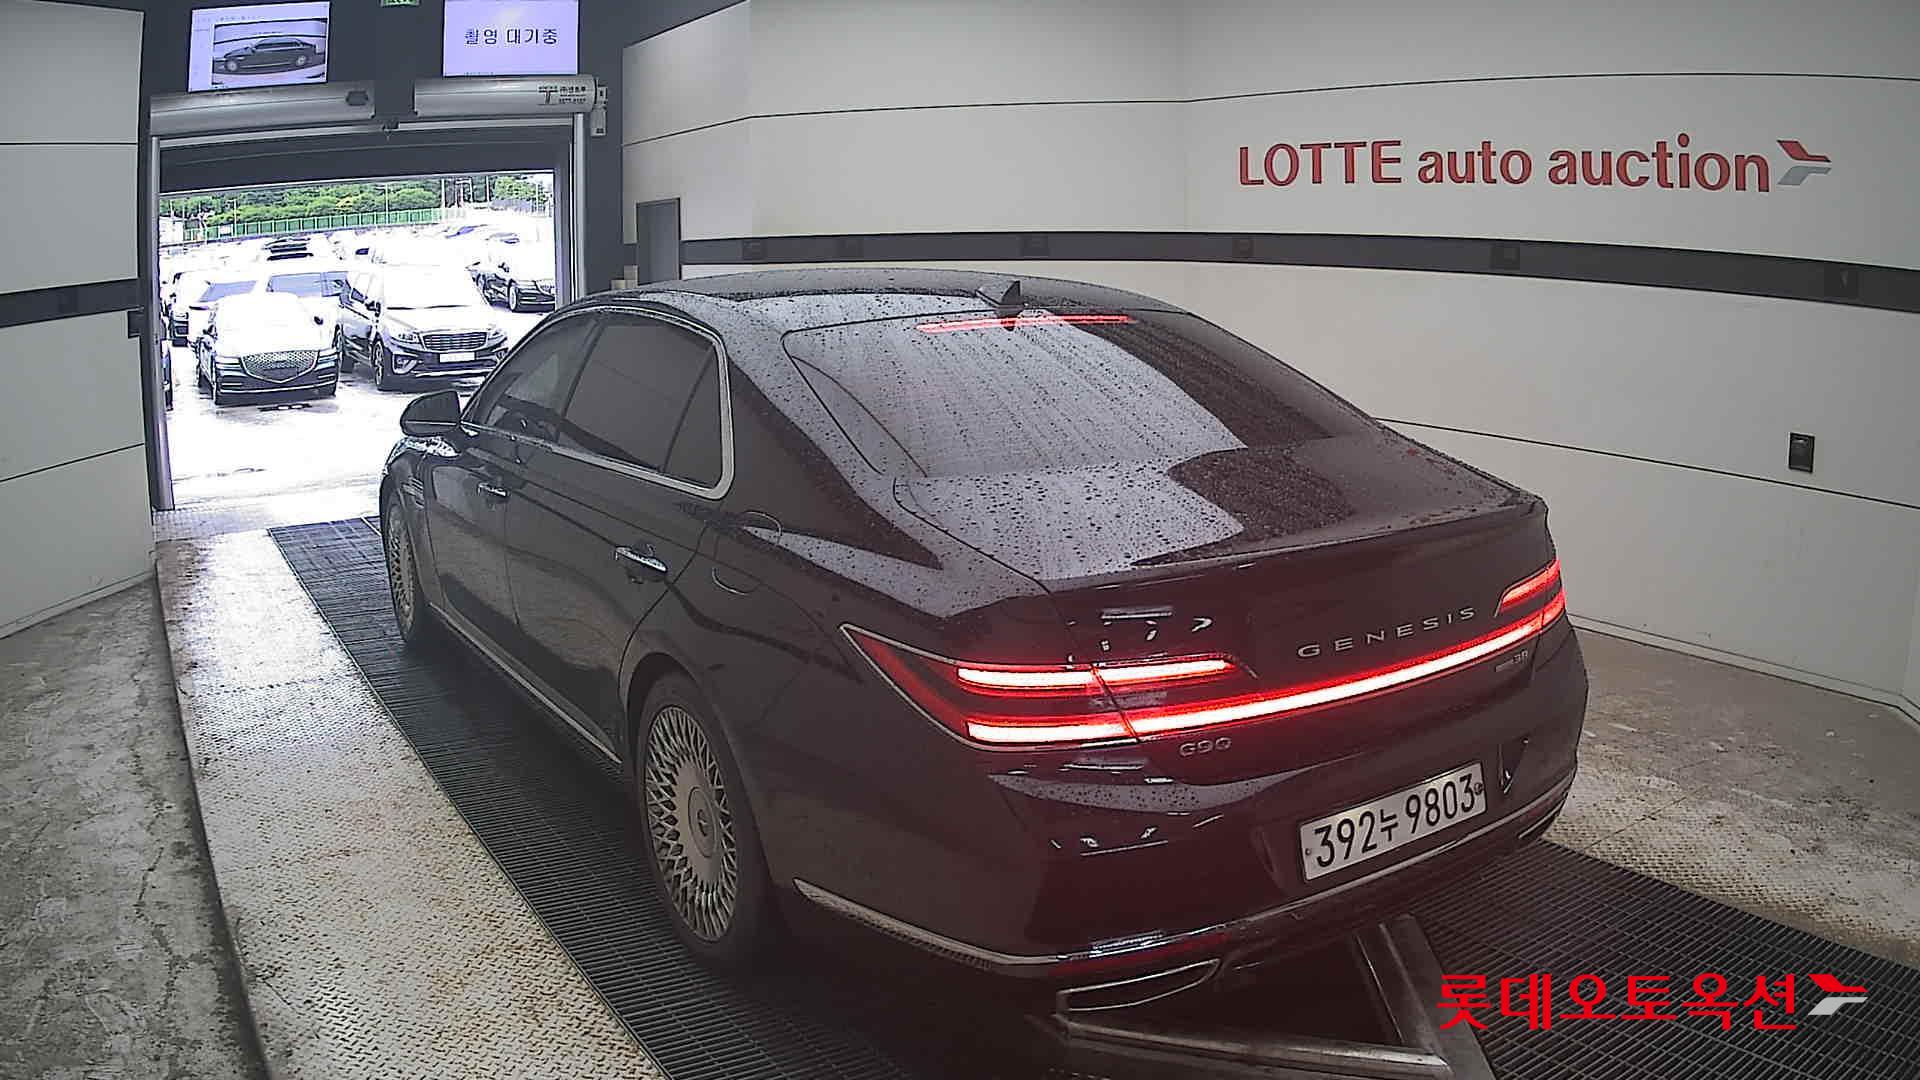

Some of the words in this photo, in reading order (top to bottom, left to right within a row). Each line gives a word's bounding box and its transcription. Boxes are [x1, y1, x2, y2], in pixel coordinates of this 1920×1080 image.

[506, 28, 557, 45] 대기중
[1239, 140, 1401, 187] LOTTE
[1417, 141, 1532, 185] auto
[1548, 133, 1770, 193] auction
[1297, 607, 1475, 658] GENESIS
[1180, 737, 1232, 757] G90
[1314, 809, 1399, 868] 392누
[1405, 773, 1476, 834] 9803
